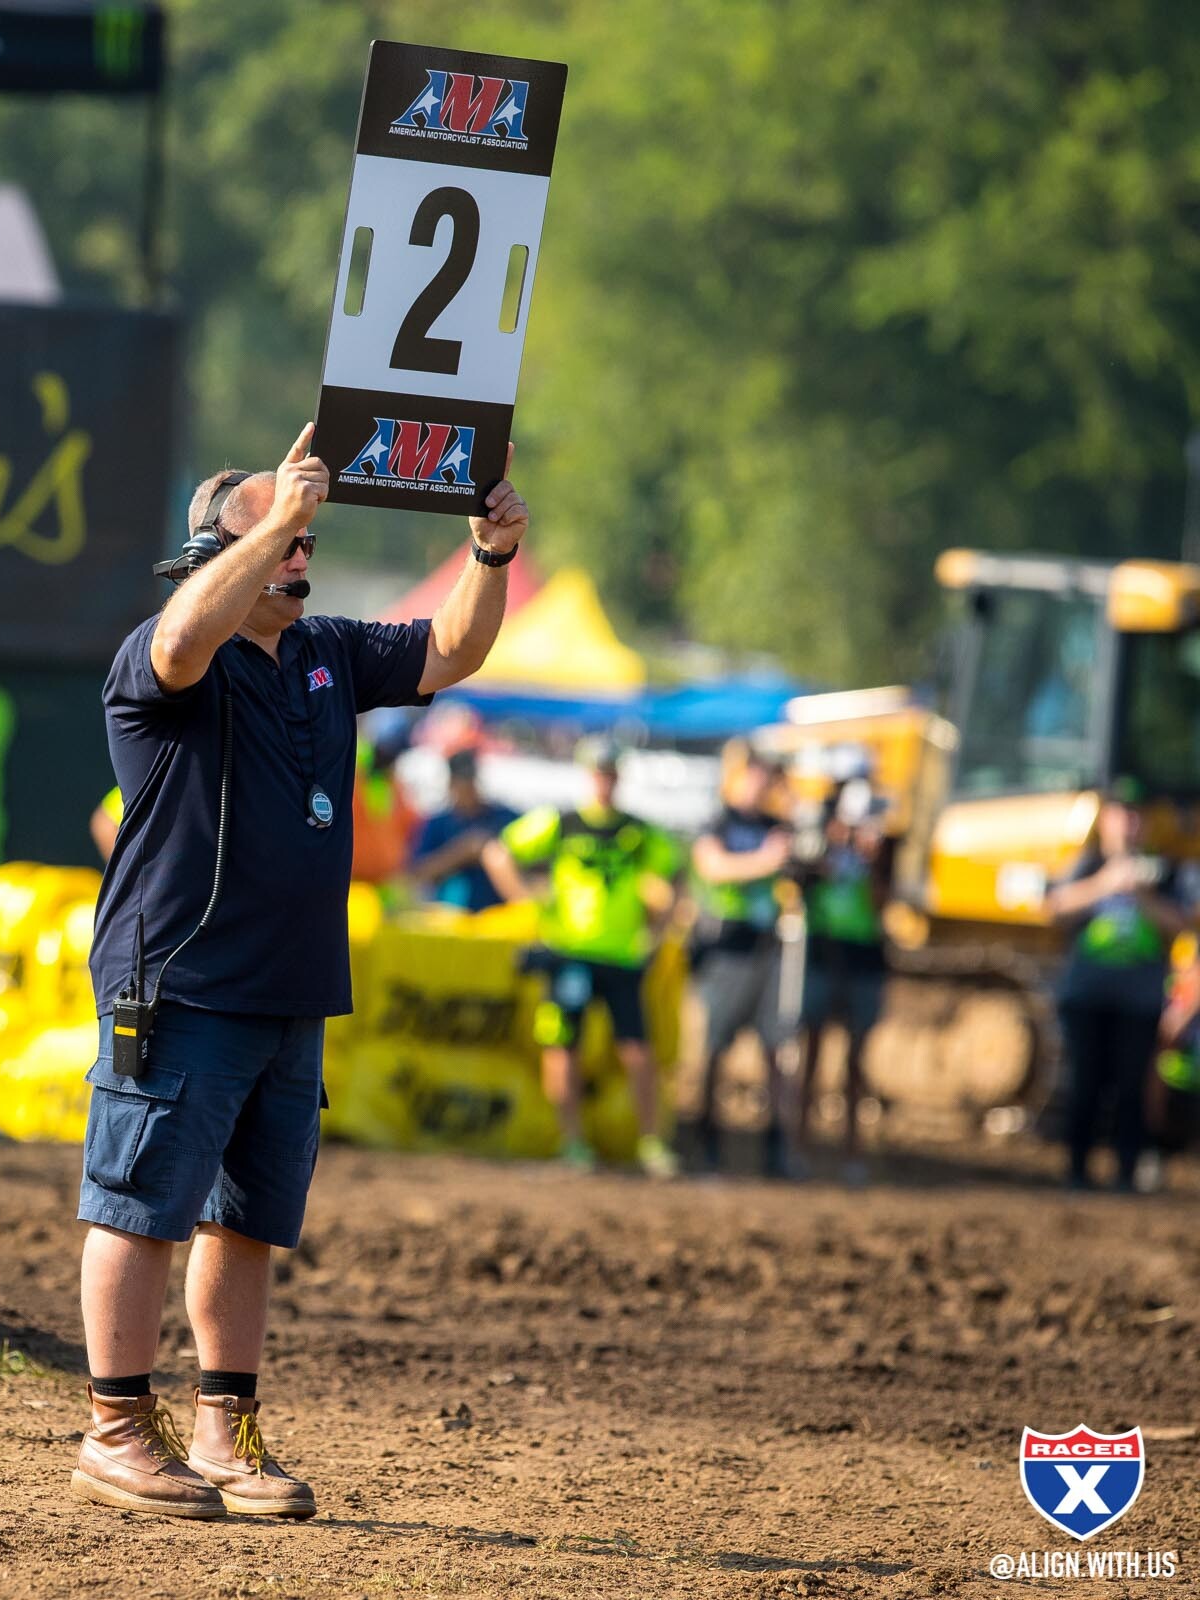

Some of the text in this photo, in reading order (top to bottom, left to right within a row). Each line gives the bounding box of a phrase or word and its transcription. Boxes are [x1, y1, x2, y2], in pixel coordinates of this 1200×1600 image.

[388, 126, 529, 150] AMERICAN MOTORCYCLIST ASSOCIATION
[390, 69, 530, 141] AMA
[389, 186, 481, 376] 2
[337, 475, 476, 496] AMERICAN MOTORCYCLIST ASSOCIATION
[339, 416, 476, 486] AMA
